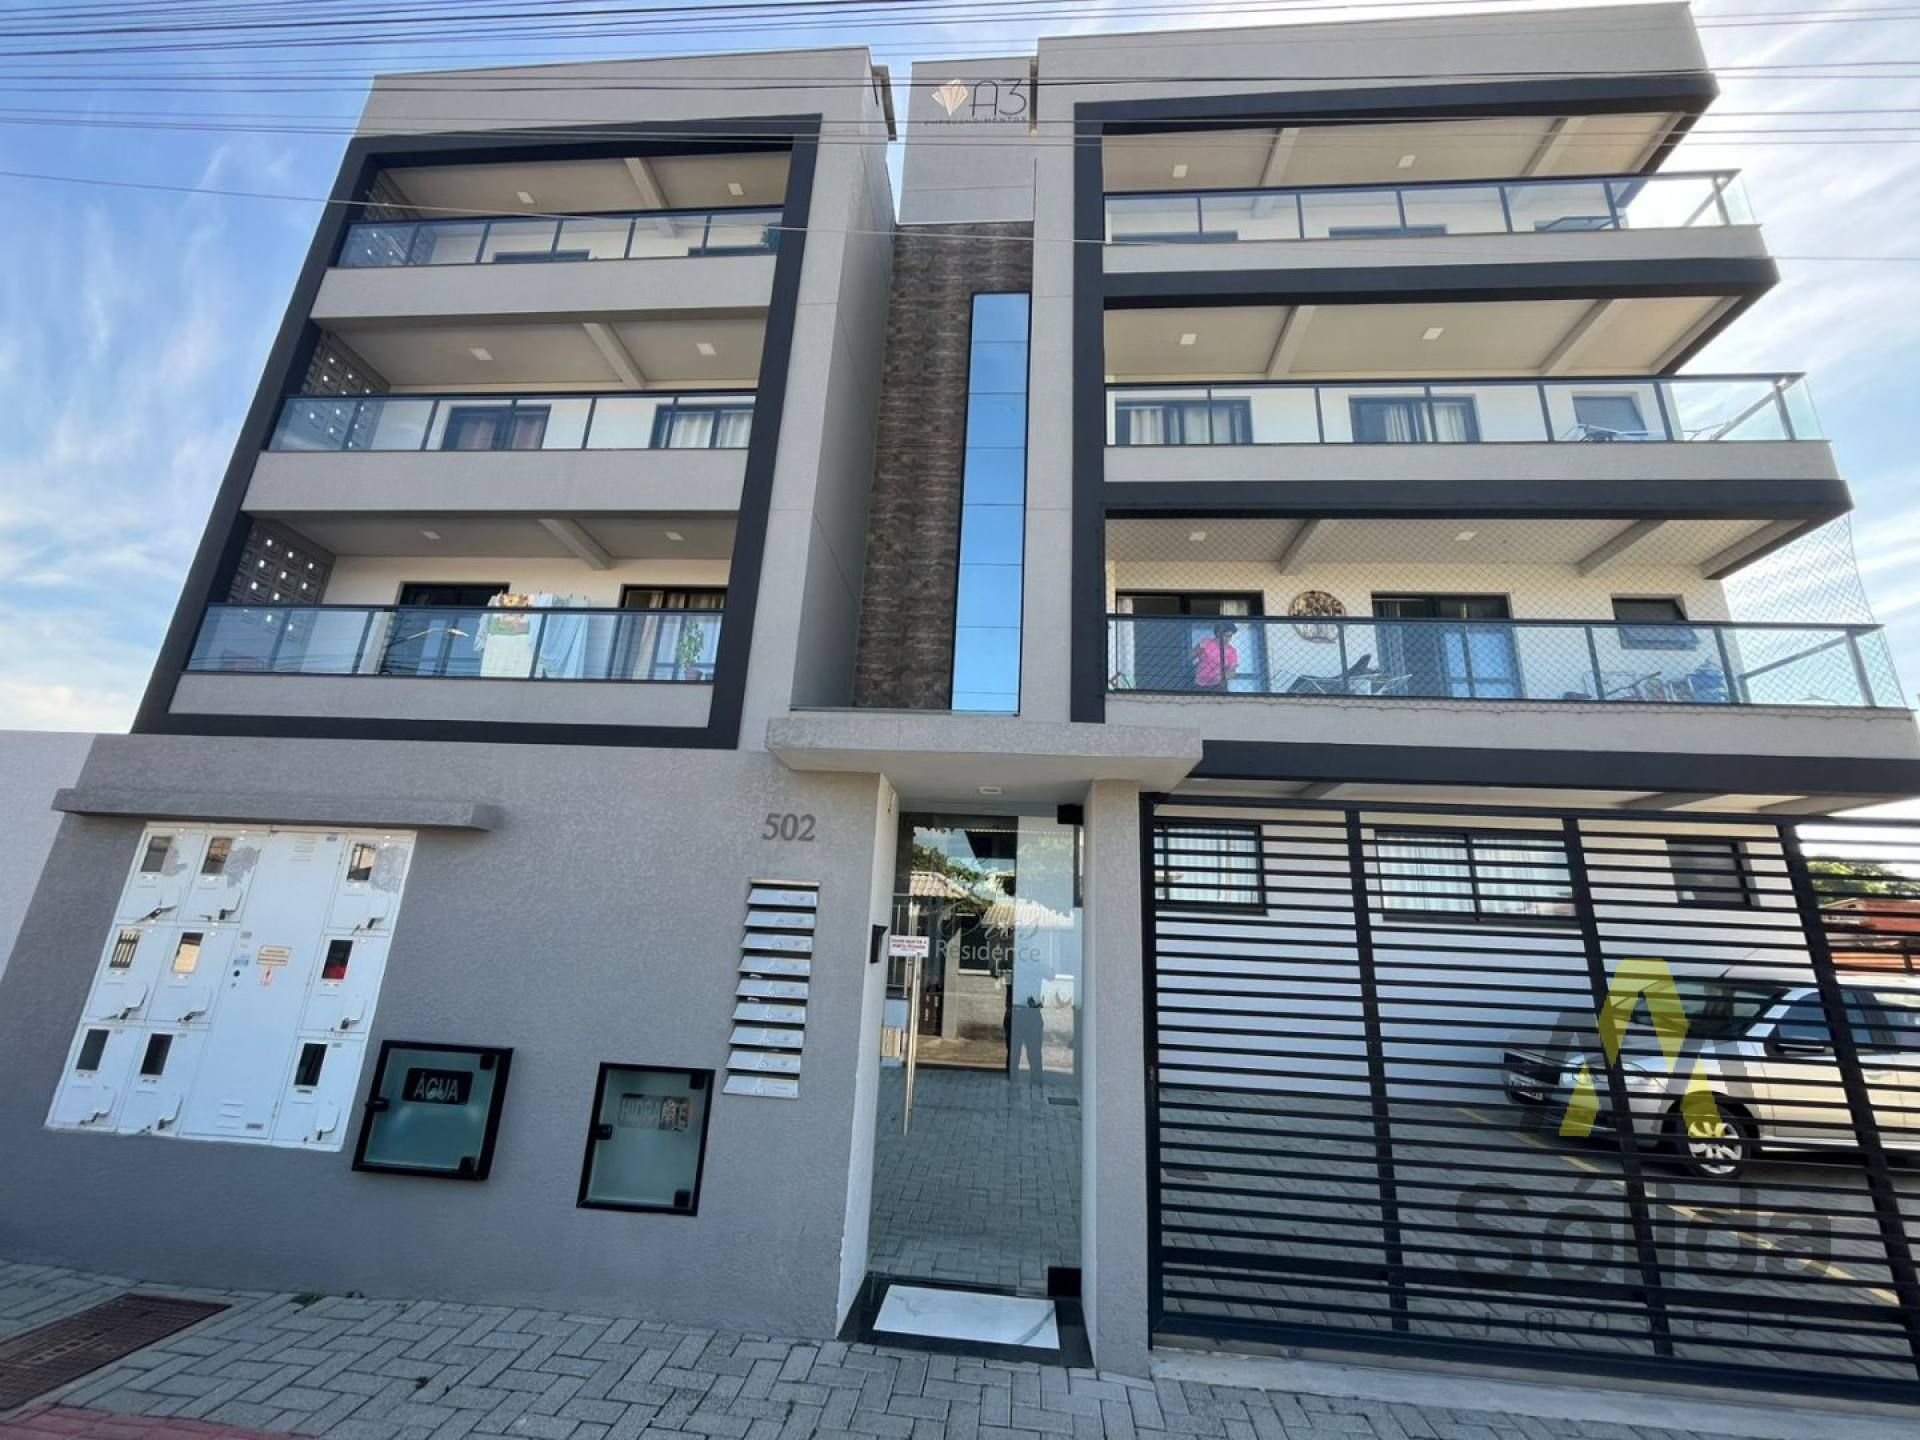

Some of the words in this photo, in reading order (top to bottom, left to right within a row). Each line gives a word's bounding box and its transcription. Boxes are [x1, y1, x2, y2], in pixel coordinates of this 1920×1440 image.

[969, 78, 1028, 117] A3
[761, 812, 817, 842] 502
[936, 939, 1041, 962] Residence
